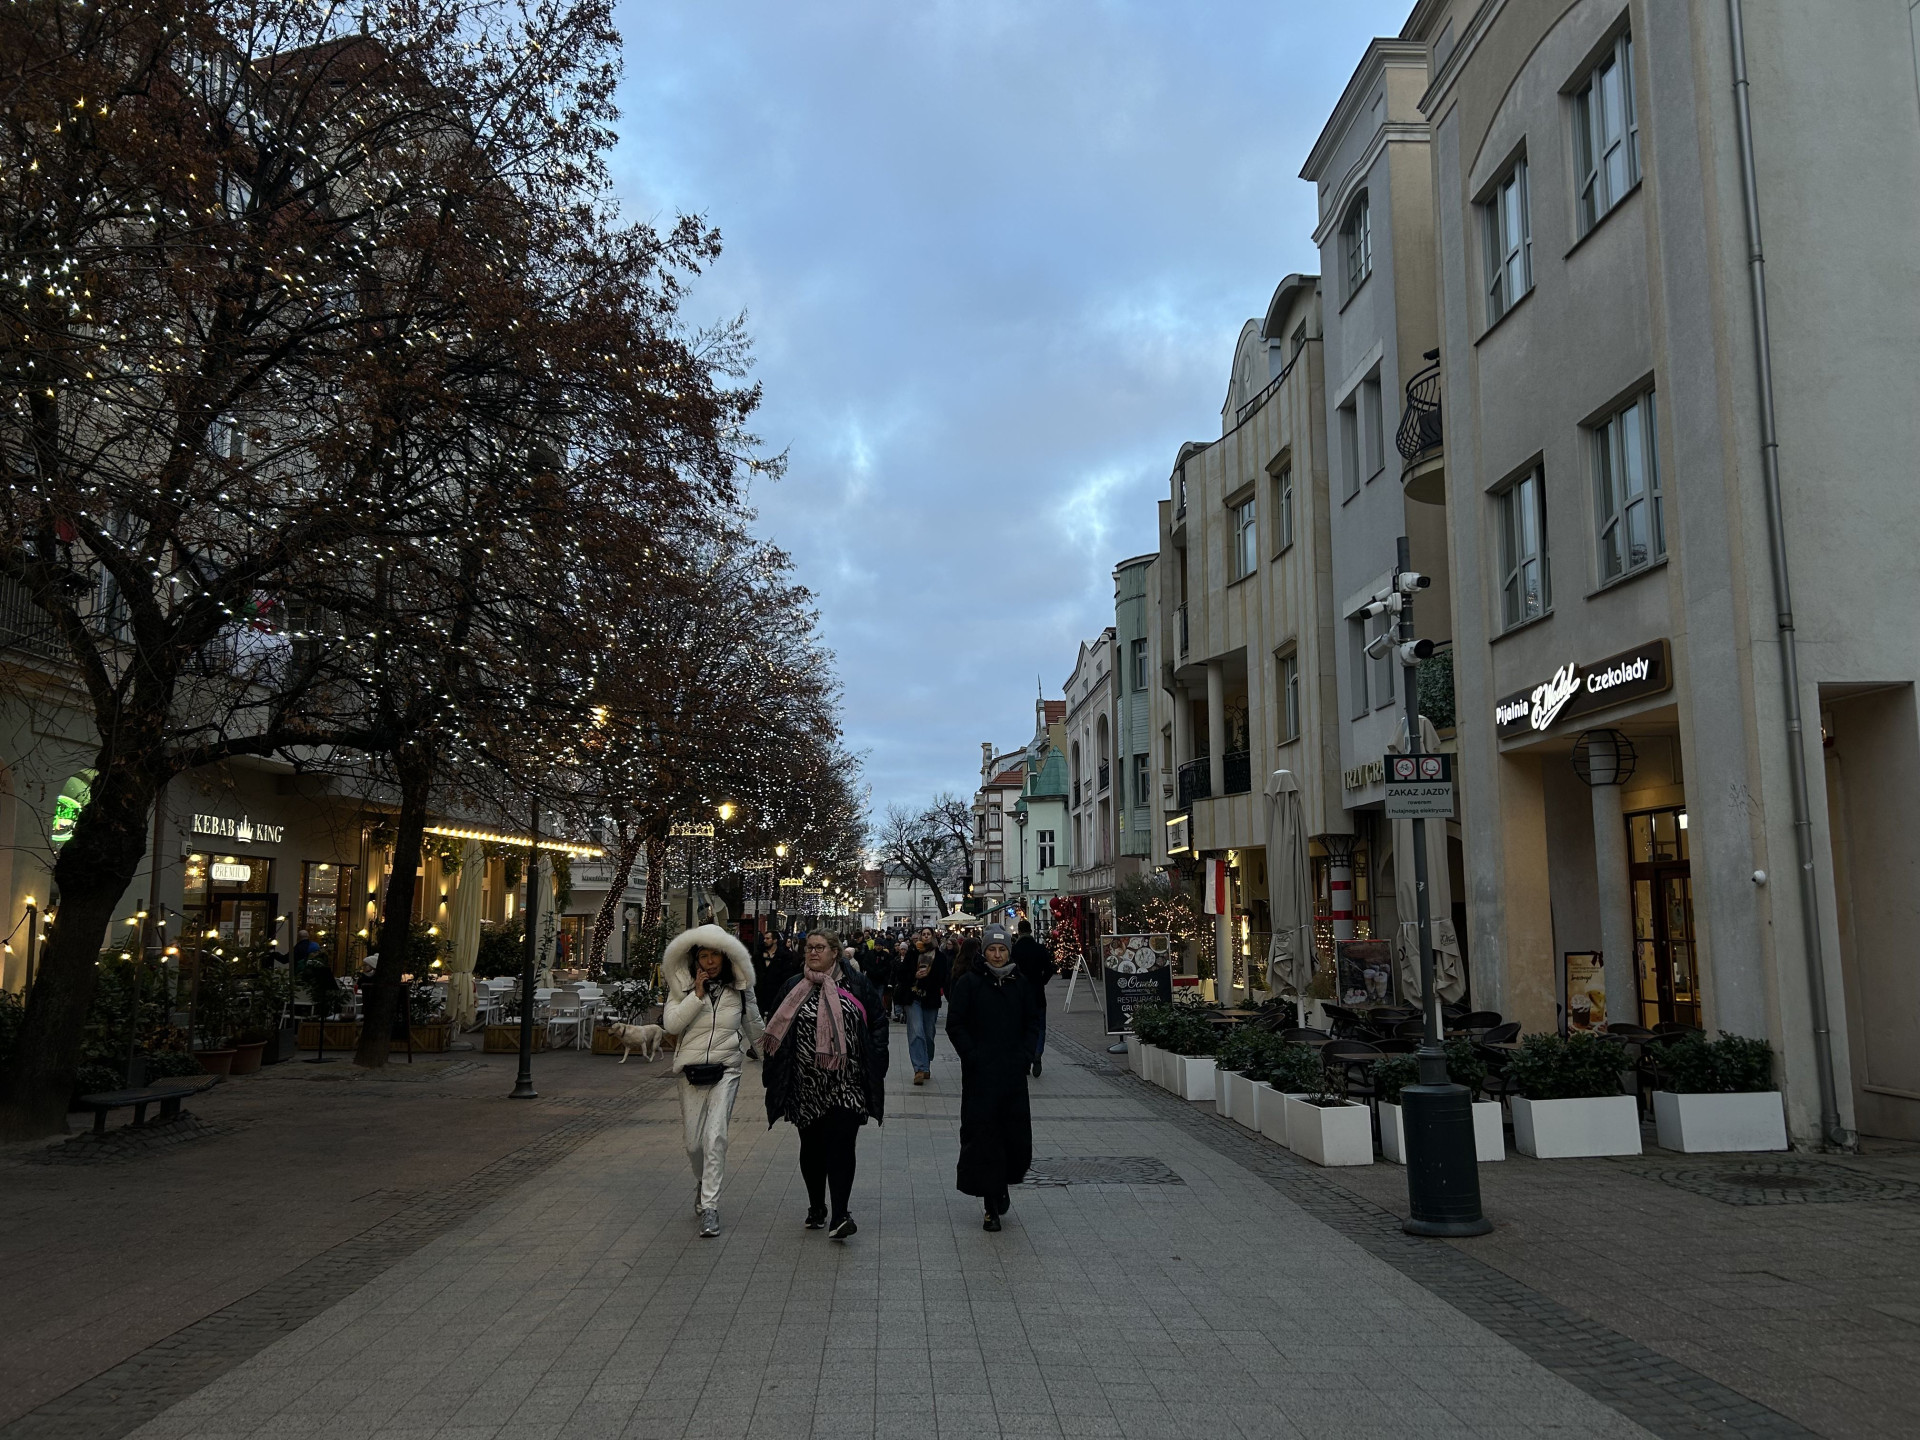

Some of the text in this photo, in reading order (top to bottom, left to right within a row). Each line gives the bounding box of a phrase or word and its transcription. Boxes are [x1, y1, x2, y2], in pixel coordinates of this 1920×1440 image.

[1496, 699, 1529, 725] Pijalnia
[1587, 657, 1649, 693] Czekolady
[1421, 788, 1450, 796] JAZDY
[193, 813, 283, 843] KEBAB KING
[215, 865, 248, 879] PREMIUM
